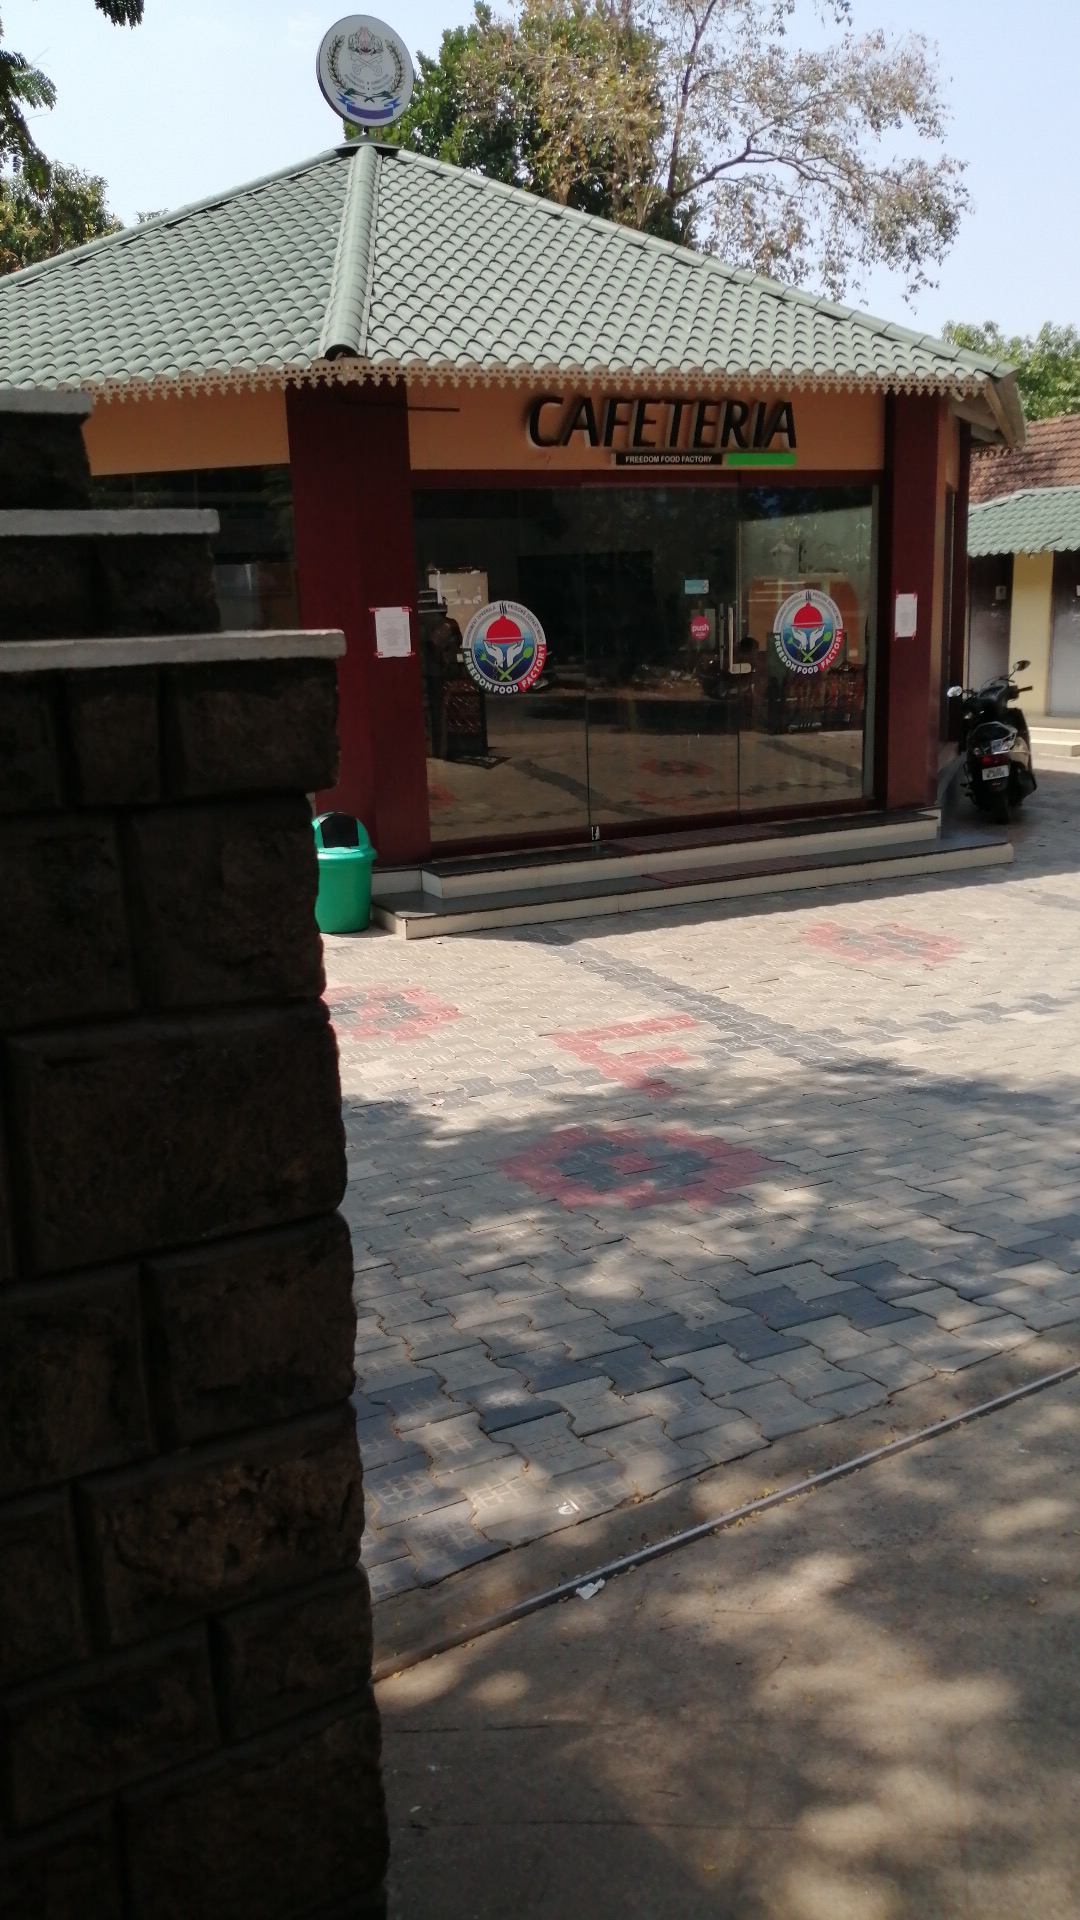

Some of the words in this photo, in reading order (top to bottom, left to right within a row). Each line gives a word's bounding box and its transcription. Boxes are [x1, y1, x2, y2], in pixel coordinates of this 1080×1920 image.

[526, 395, 797, 449] CAFETERIA
[625, 455, 659, 463] FREEDOM
[661, 455, 680, 463] FOOD
[681, 455, 712, 463] FACTORY
[692, 624, 709, 632] push
[463, 651, 492, 691] FREEDOM
[493, 685, 519, 694] FOOD
[521, 646, 545, 688] FACTORY
[774, 634, 797, 671] FREEDOM
[797, 666, 819, 675] FOOD
[820, 630, 843, 668] FACTORY
